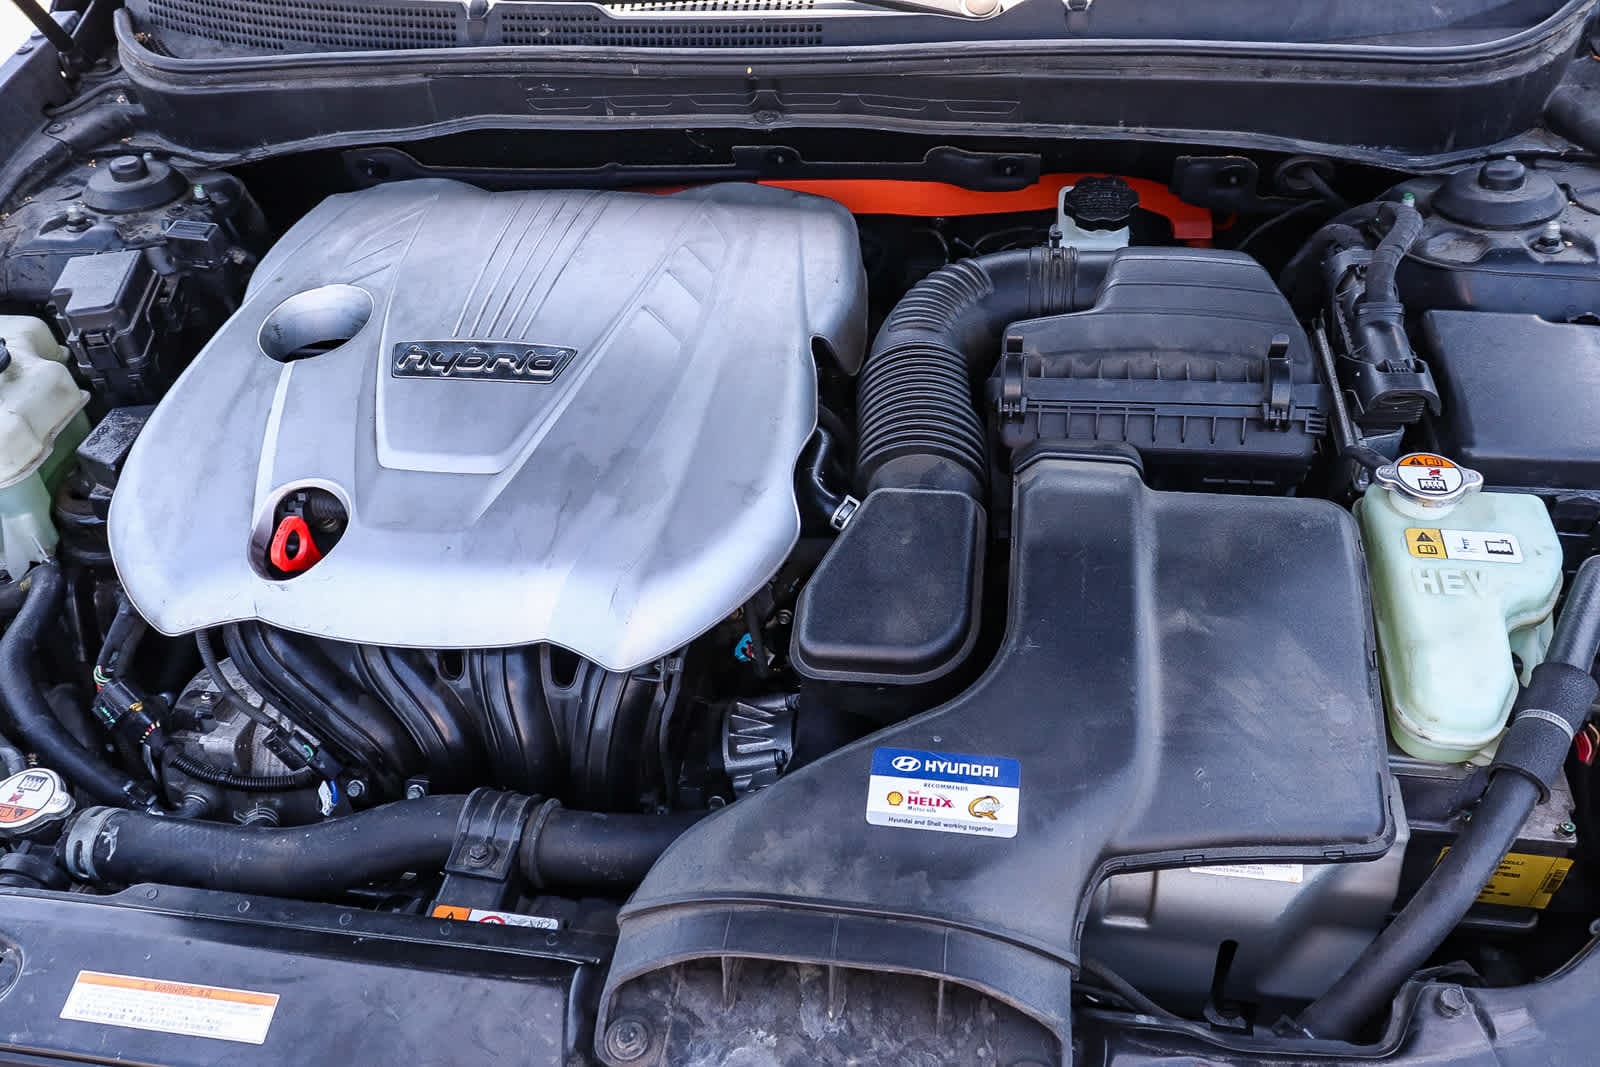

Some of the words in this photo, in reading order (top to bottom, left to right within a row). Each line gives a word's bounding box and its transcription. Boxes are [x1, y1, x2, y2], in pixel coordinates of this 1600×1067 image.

[396, 345, 567, 376] hybrid
[1412, 568, 1486, 597] HEV
[925, 759, 999, 778] HYUNDAI
[924, 783, 968, 791] RECOMMENDS
[908, 796, 953, 808] HELIX
[888, 816, 913, 825] Hyundai
[943, 823, 967, 831] working
[968, 824, 994, 832] together
